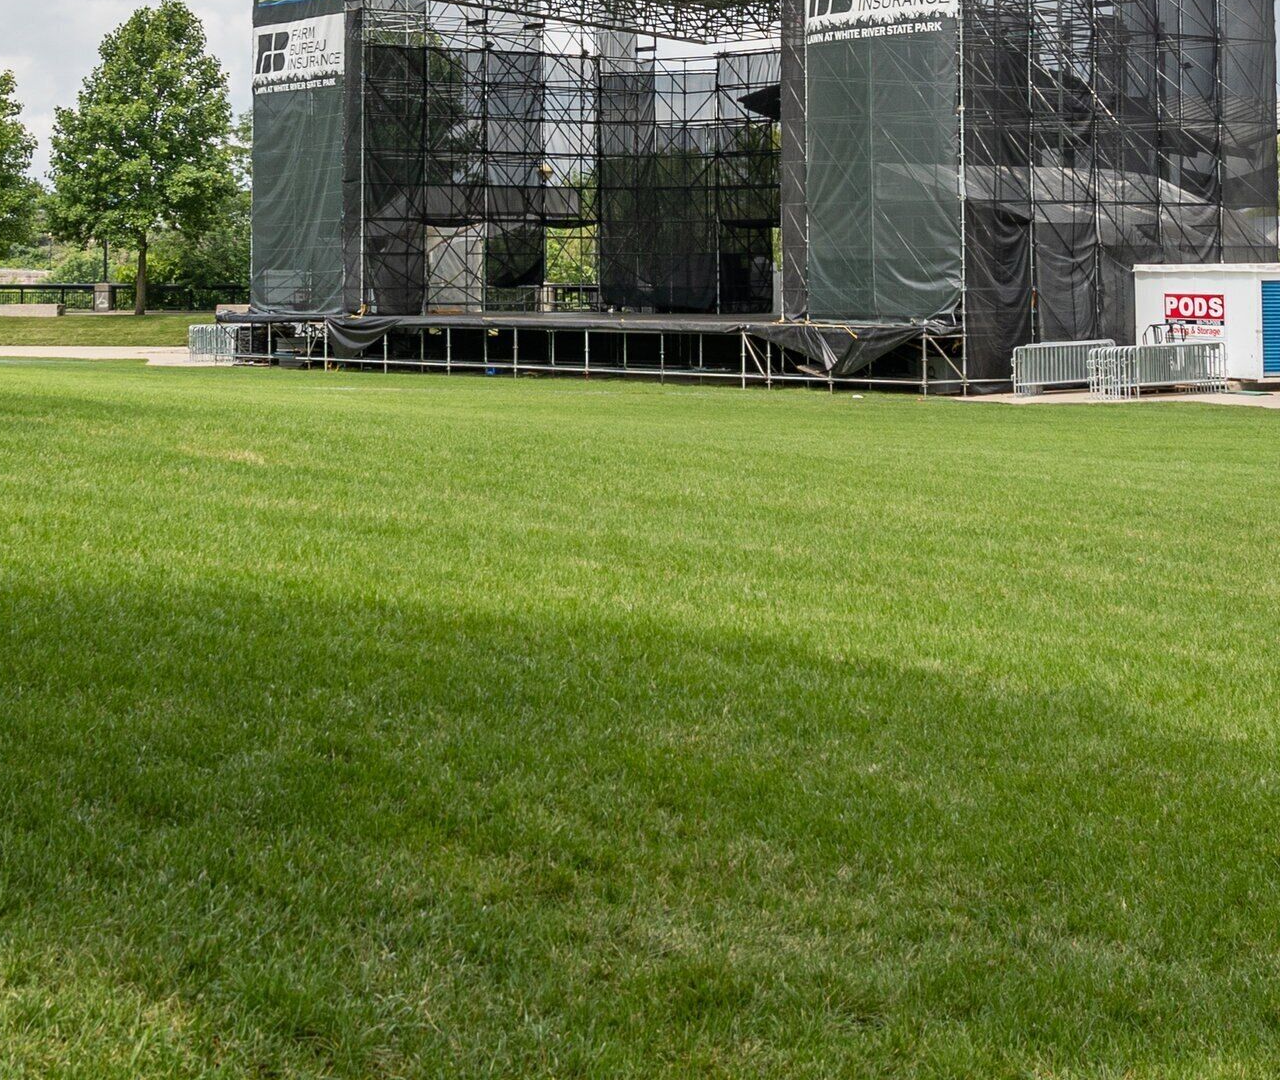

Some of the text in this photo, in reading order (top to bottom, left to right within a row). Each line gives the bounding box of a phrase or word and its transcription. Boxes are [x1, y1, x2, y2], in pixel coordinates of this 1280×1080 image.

[291, 26, 315, 42] FARM
[807, 21, 943, 45] LAWN AT WHITE RIVER STATE PARK
[289, 39, 327, 56] BUREAU
[287, 51, 341, 71] INSURANCE
[322, 78, 336, 87] PARK
[1165, 296, 1224, 318] PODS
[1197, 325, 1221, 337] Storage
